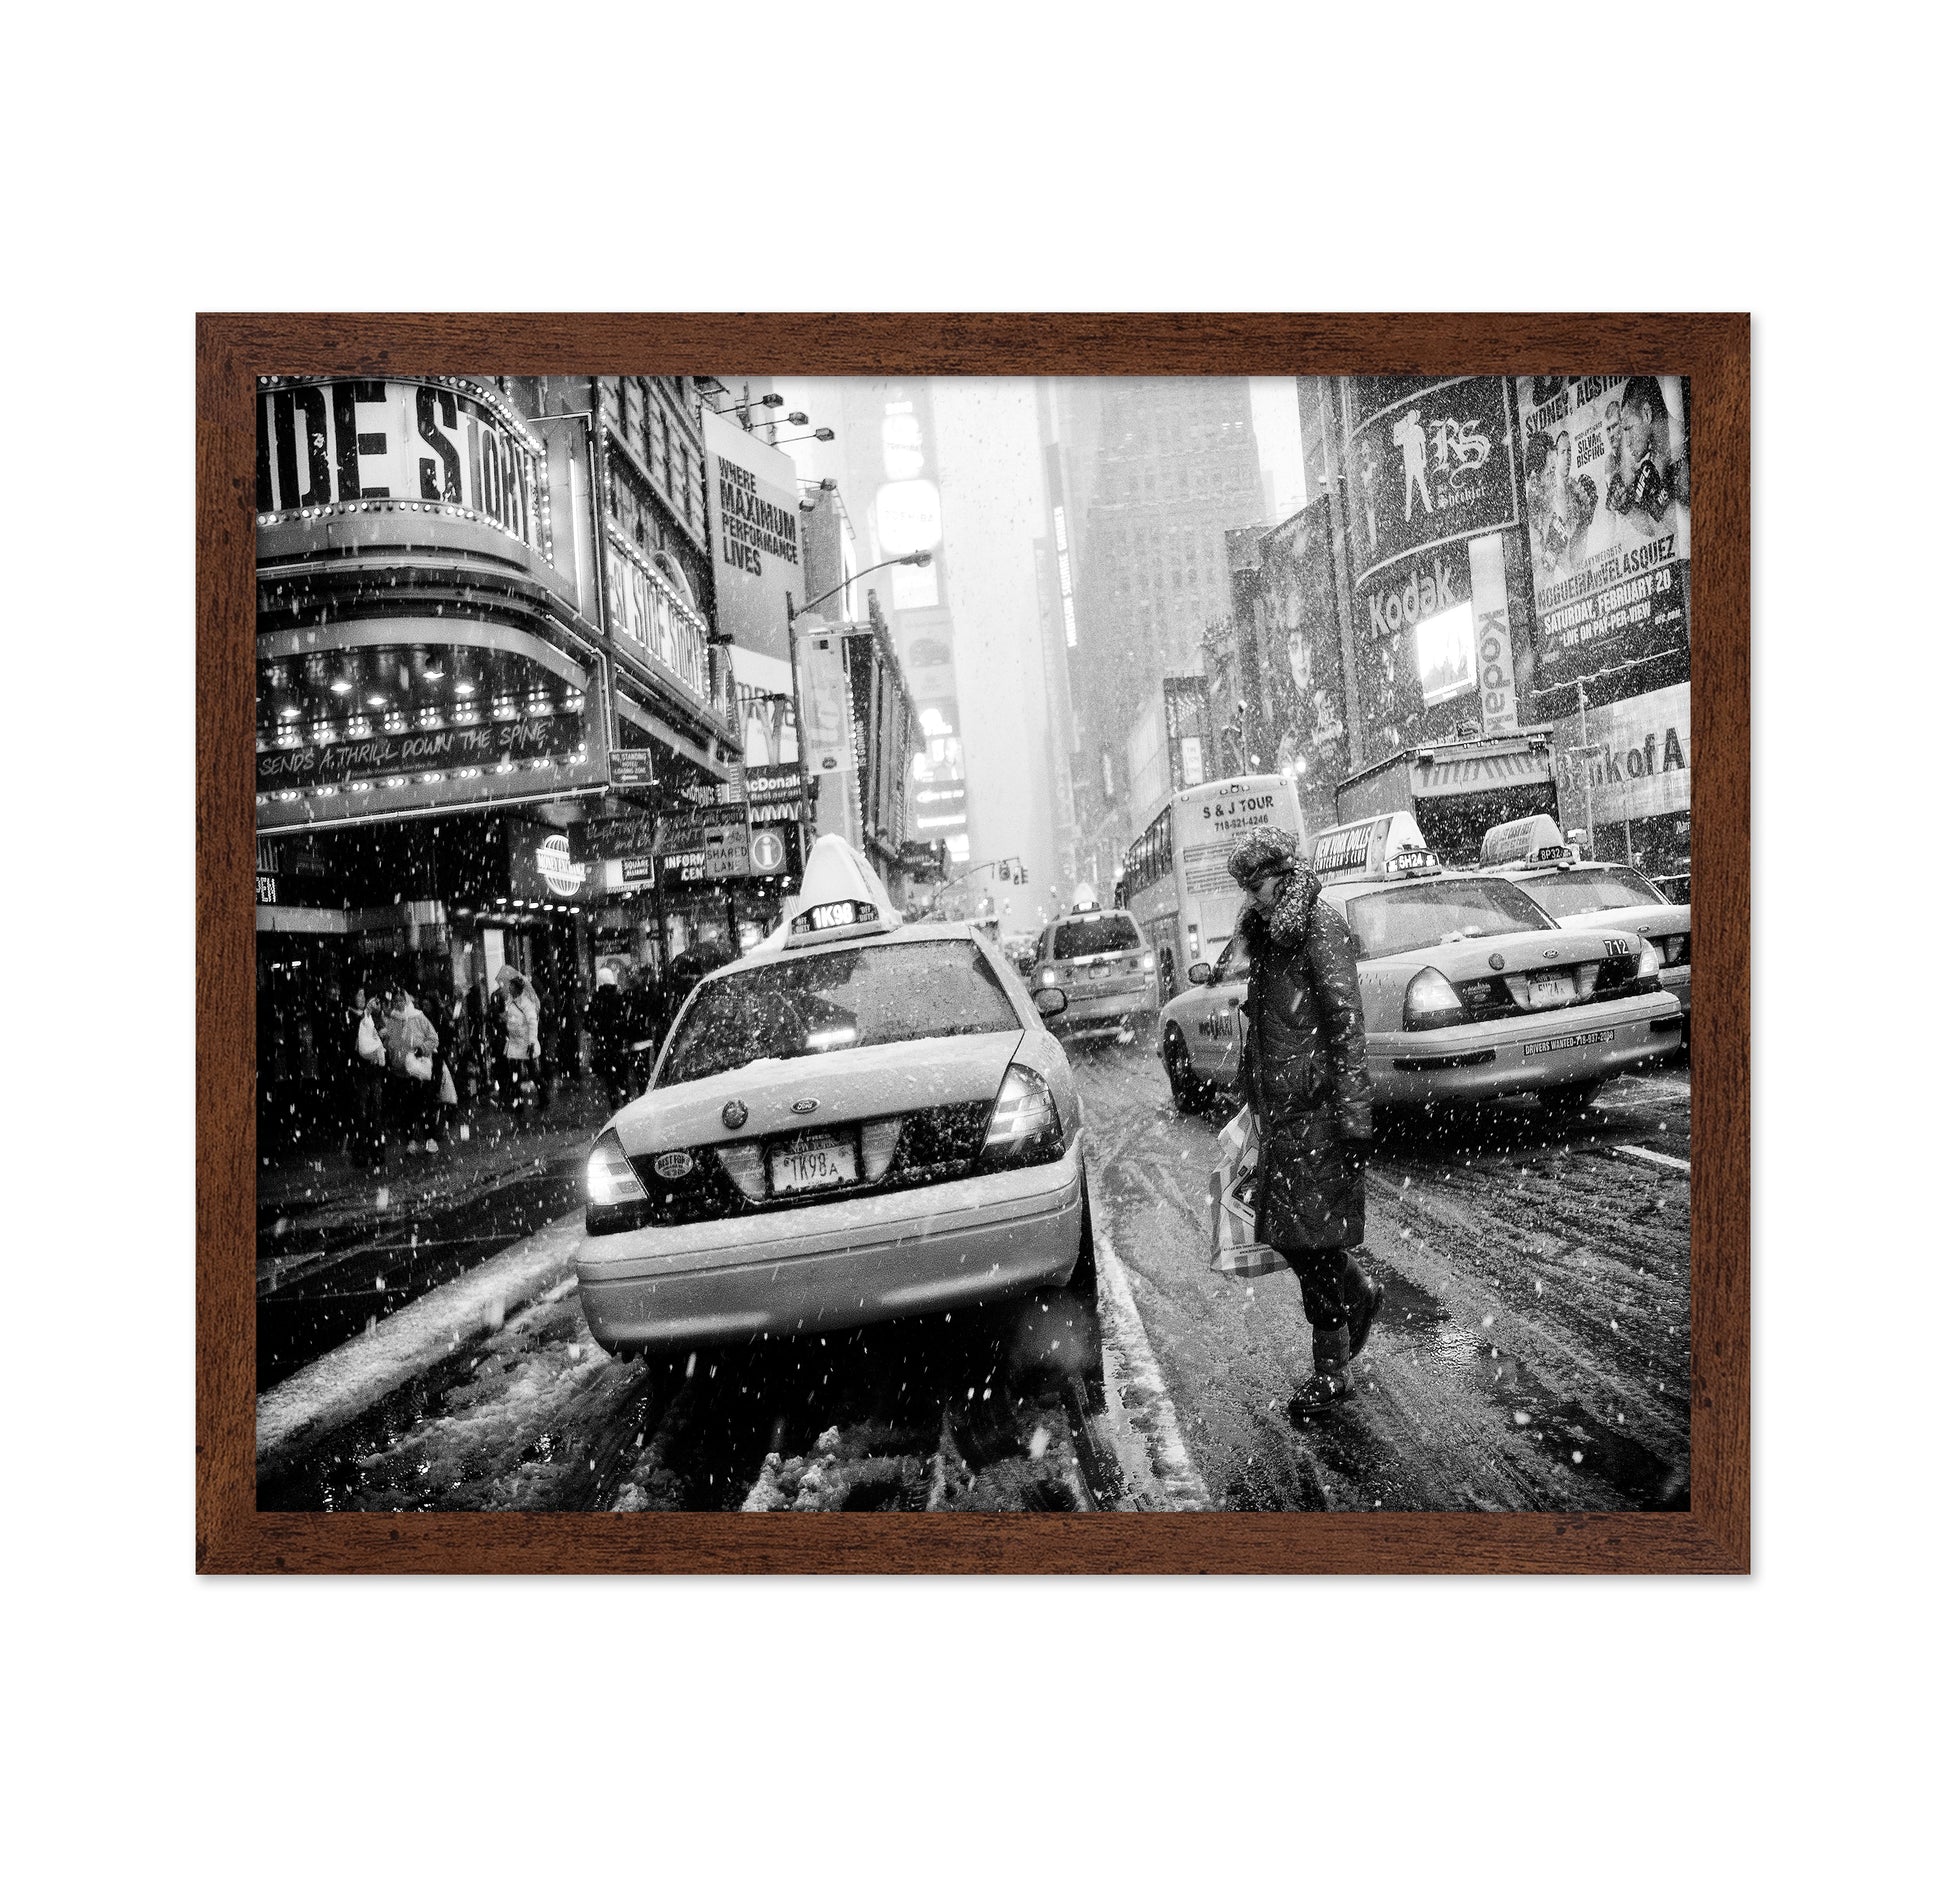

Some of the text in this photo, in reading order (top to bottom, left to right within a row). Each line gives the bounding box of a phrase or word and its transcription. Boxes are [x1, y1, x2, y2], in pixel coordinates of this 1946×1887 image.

[1526, 390, 1574, 436] SYDNEY,
[416, 385, 534, 546] STORY
[718, 455, 757, 494] WHERE
[720, 478, 797, 544] MAXIMUM
[722, 511, 798, 565] PERFORMANCE
[723, 535, 762, 576] LIVES
[1600, 533, 1676, 583] VELASQUEZ
[1369, 559, 1456, 639] Kodak
[1597, 574, 1652, 614] FEBRUARY
[1655, 568, 1672, 594] 20
[1478, 609, 1514, 731] Kodak
[259, 753, 315, 776] SENDS
[337, 743, 399, 766] THRILL
[402, 732, 452, 758] DOWN
[458, 728, 493, 750] THE
[500, 717, 550, 748] SPINE
[1627, 733, 1656, 778] of
[1203, 796, 1274, 819] S & J TOUR
[707, 846, 748, 860] SHARED
[714, 860, 740, 873] LANE
[812, 902, 853, 928] 1K98
[1605, 939, 1629, 955] 712
[1525, 1041, 1551, 1056] DRIVERS
